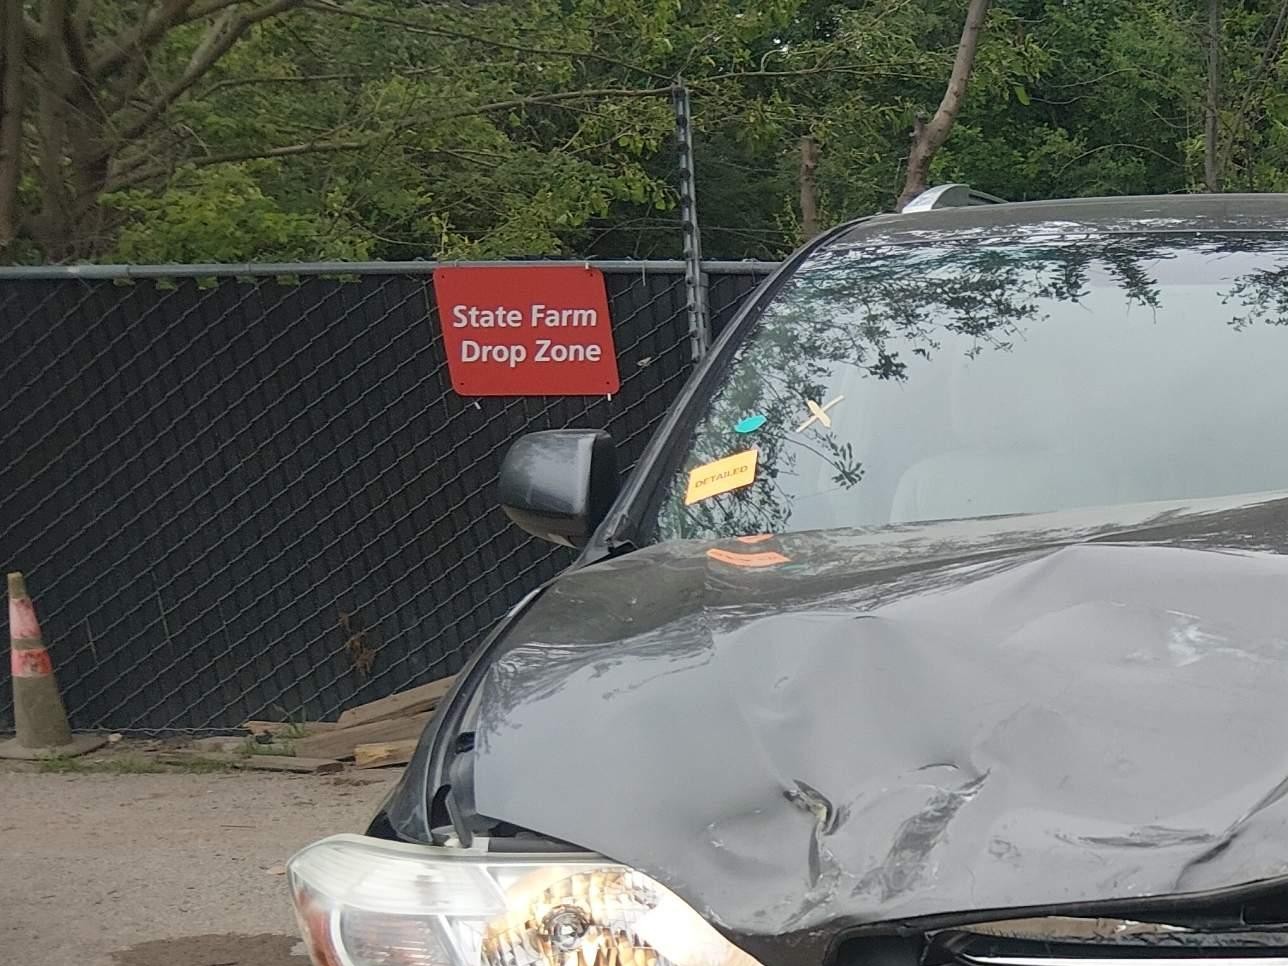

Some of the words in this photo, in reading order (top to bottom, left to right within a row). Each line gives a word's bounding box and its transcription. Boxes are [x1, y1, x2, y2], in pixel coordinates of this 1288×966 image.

[452, 304, 523, 328] State
[530, 304, 598, 327] Farm
[461, 340, 527, 368] Drop
[534, 339, 602, 362] Zone
[694, 464, 749, 489] DETAILED
